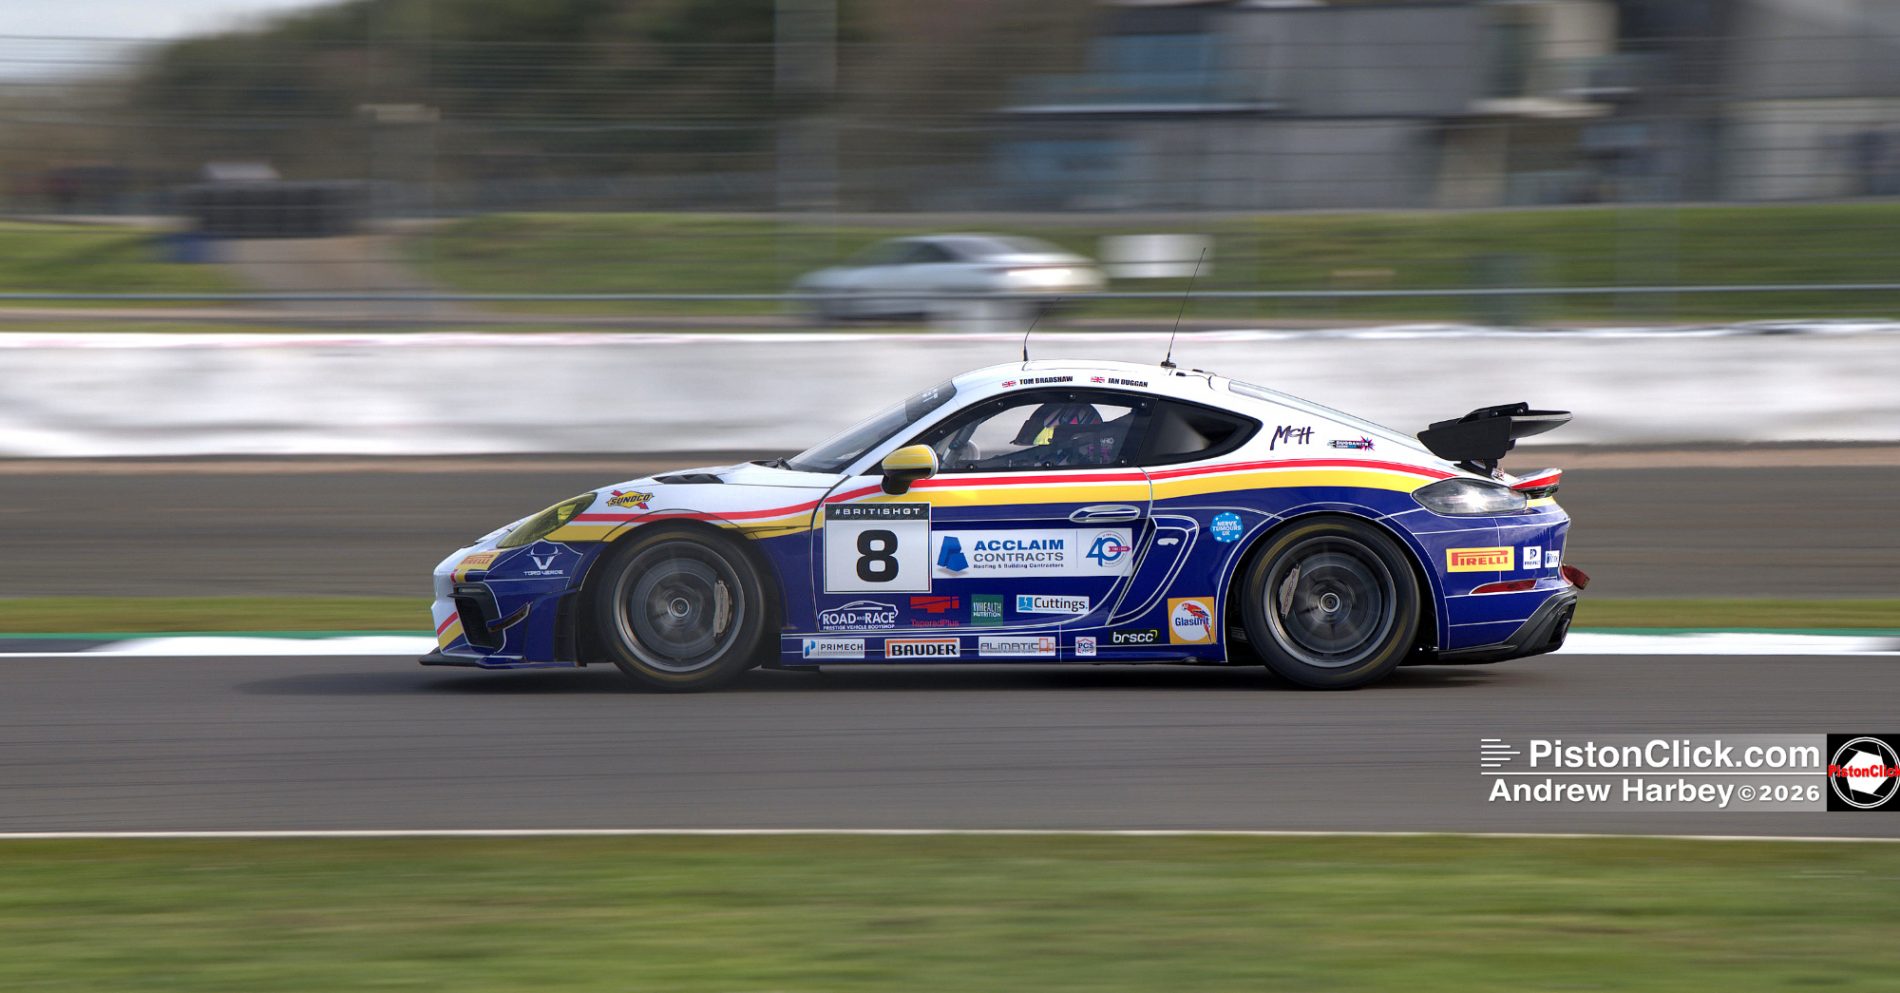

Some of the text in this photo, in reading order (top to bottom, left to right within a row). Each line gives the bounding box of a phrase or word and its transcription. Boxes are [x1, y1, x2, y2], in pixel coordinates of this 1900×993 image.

[1035, 376, 1073, 384] BRADSHAW
[1120, 379, 1148, 388] DUGGAN
[611, 494, 650, 505] SUNOCO
[974, 539, 1064, 551] ACCLAIM
[856, 529, 899, 582] 8
[973, 552, 1064, 562] CONTRACTS
[1451, 550, 1508, 566] PIRELLI
[823, 613, 856, 625] ROAD
[865, 612, 895, 623] RACE
[1113, 632, 1153, 643] brscc
[891, 644, 956, 656] BAUDER
